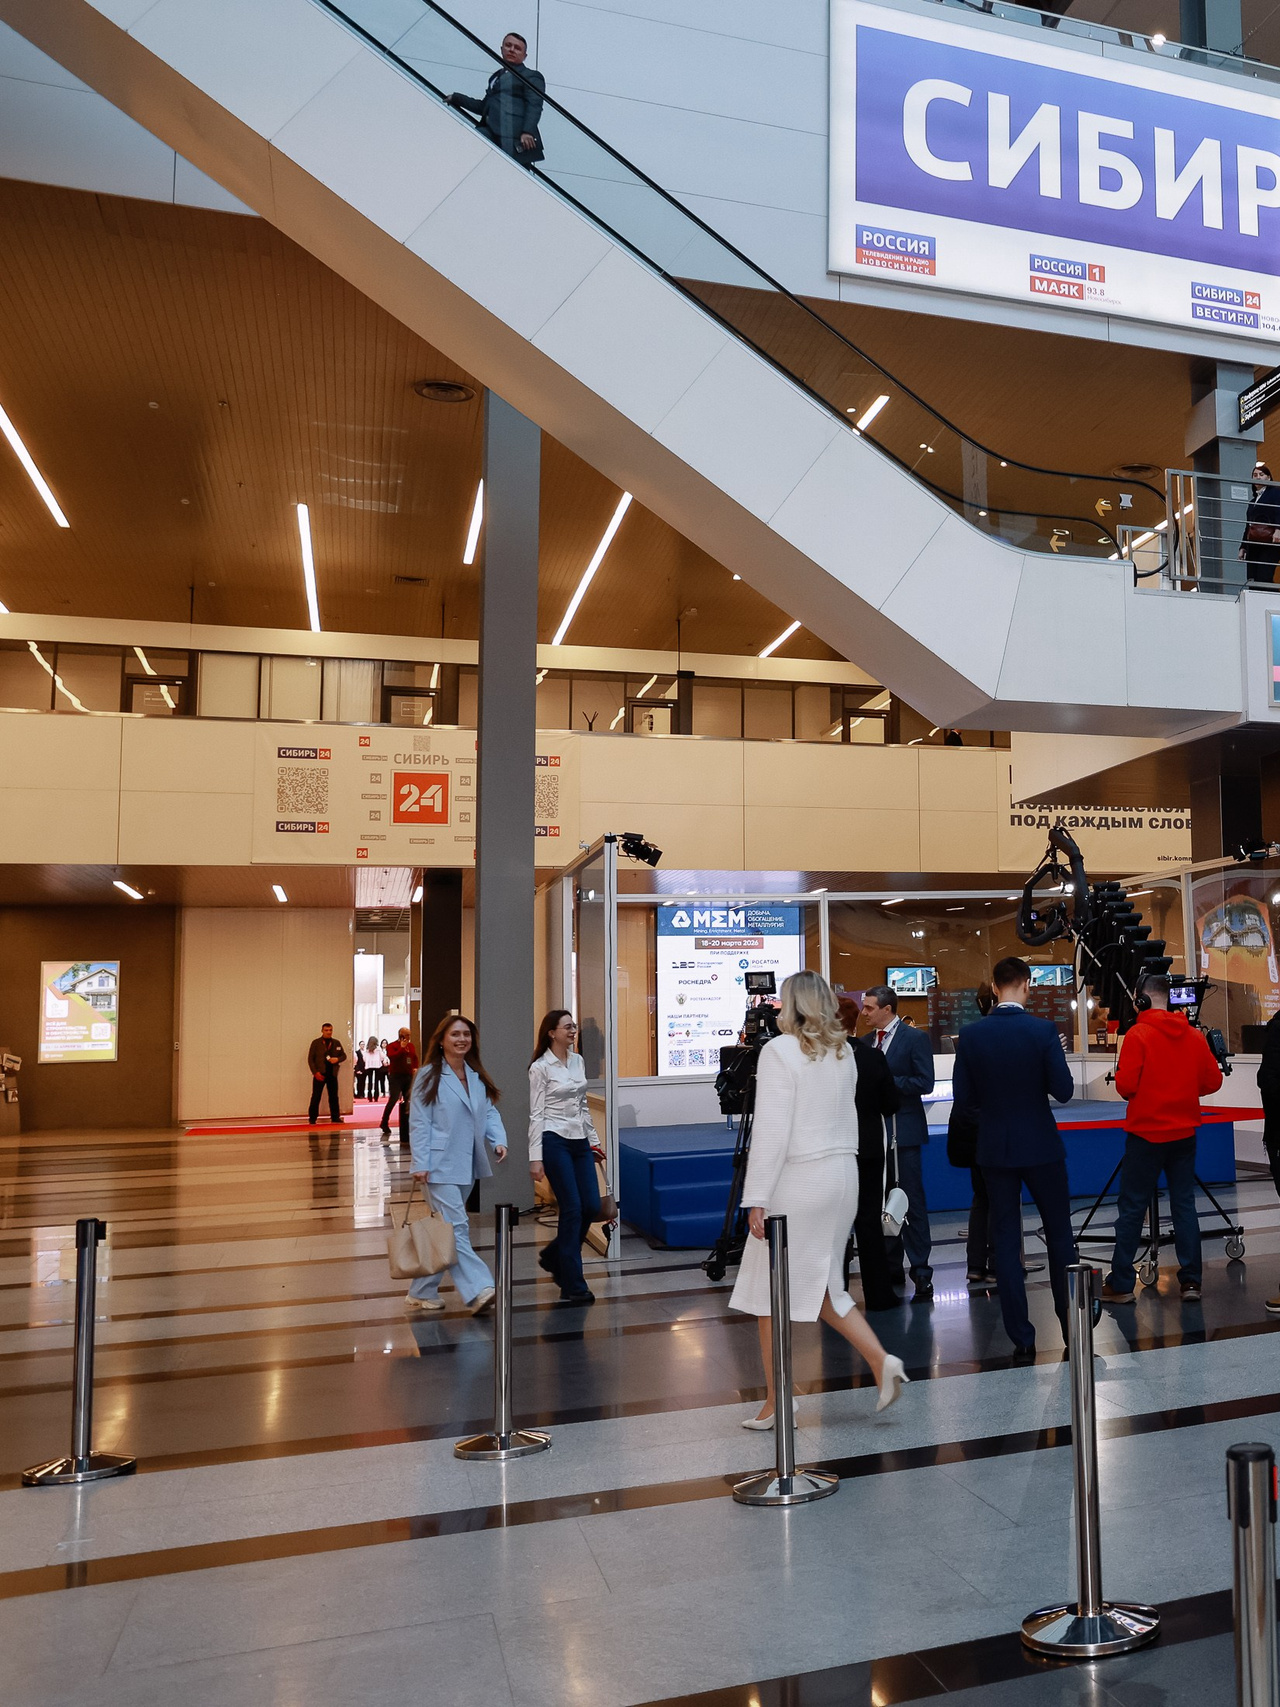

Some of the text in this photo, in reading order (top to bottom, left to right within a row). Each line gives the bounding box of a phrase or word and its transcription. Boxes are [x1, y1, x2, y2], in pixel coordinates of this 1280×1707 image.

[862, 230, 930, 255] РОССИЯ
[862, 250, 903, 261] ТЕЛЕВИДЕНИЕ
[909, 258, 930, 266] РАДИО
[862, 257, 930, 275] НОВОСИБИРСК
[1034, 258, 1100, 281] РОССИЯ 1
[1034, 279, 1080, 297] МАЯК
[1087, 286, 1105, 296] 93.8
[1194, 285, 1260, 307] СИБИРЬ 24
[280, 749, 316, 757] СИБИРЬ
[394, 753, 450, 766] СИБИРЬ
[399, 783, 443, 813] 24
[278, 823, 314, 831] СИБИРЬ
[1010, 814, 1050, 829] под
[1055, 815, 1143, 830] каждым
